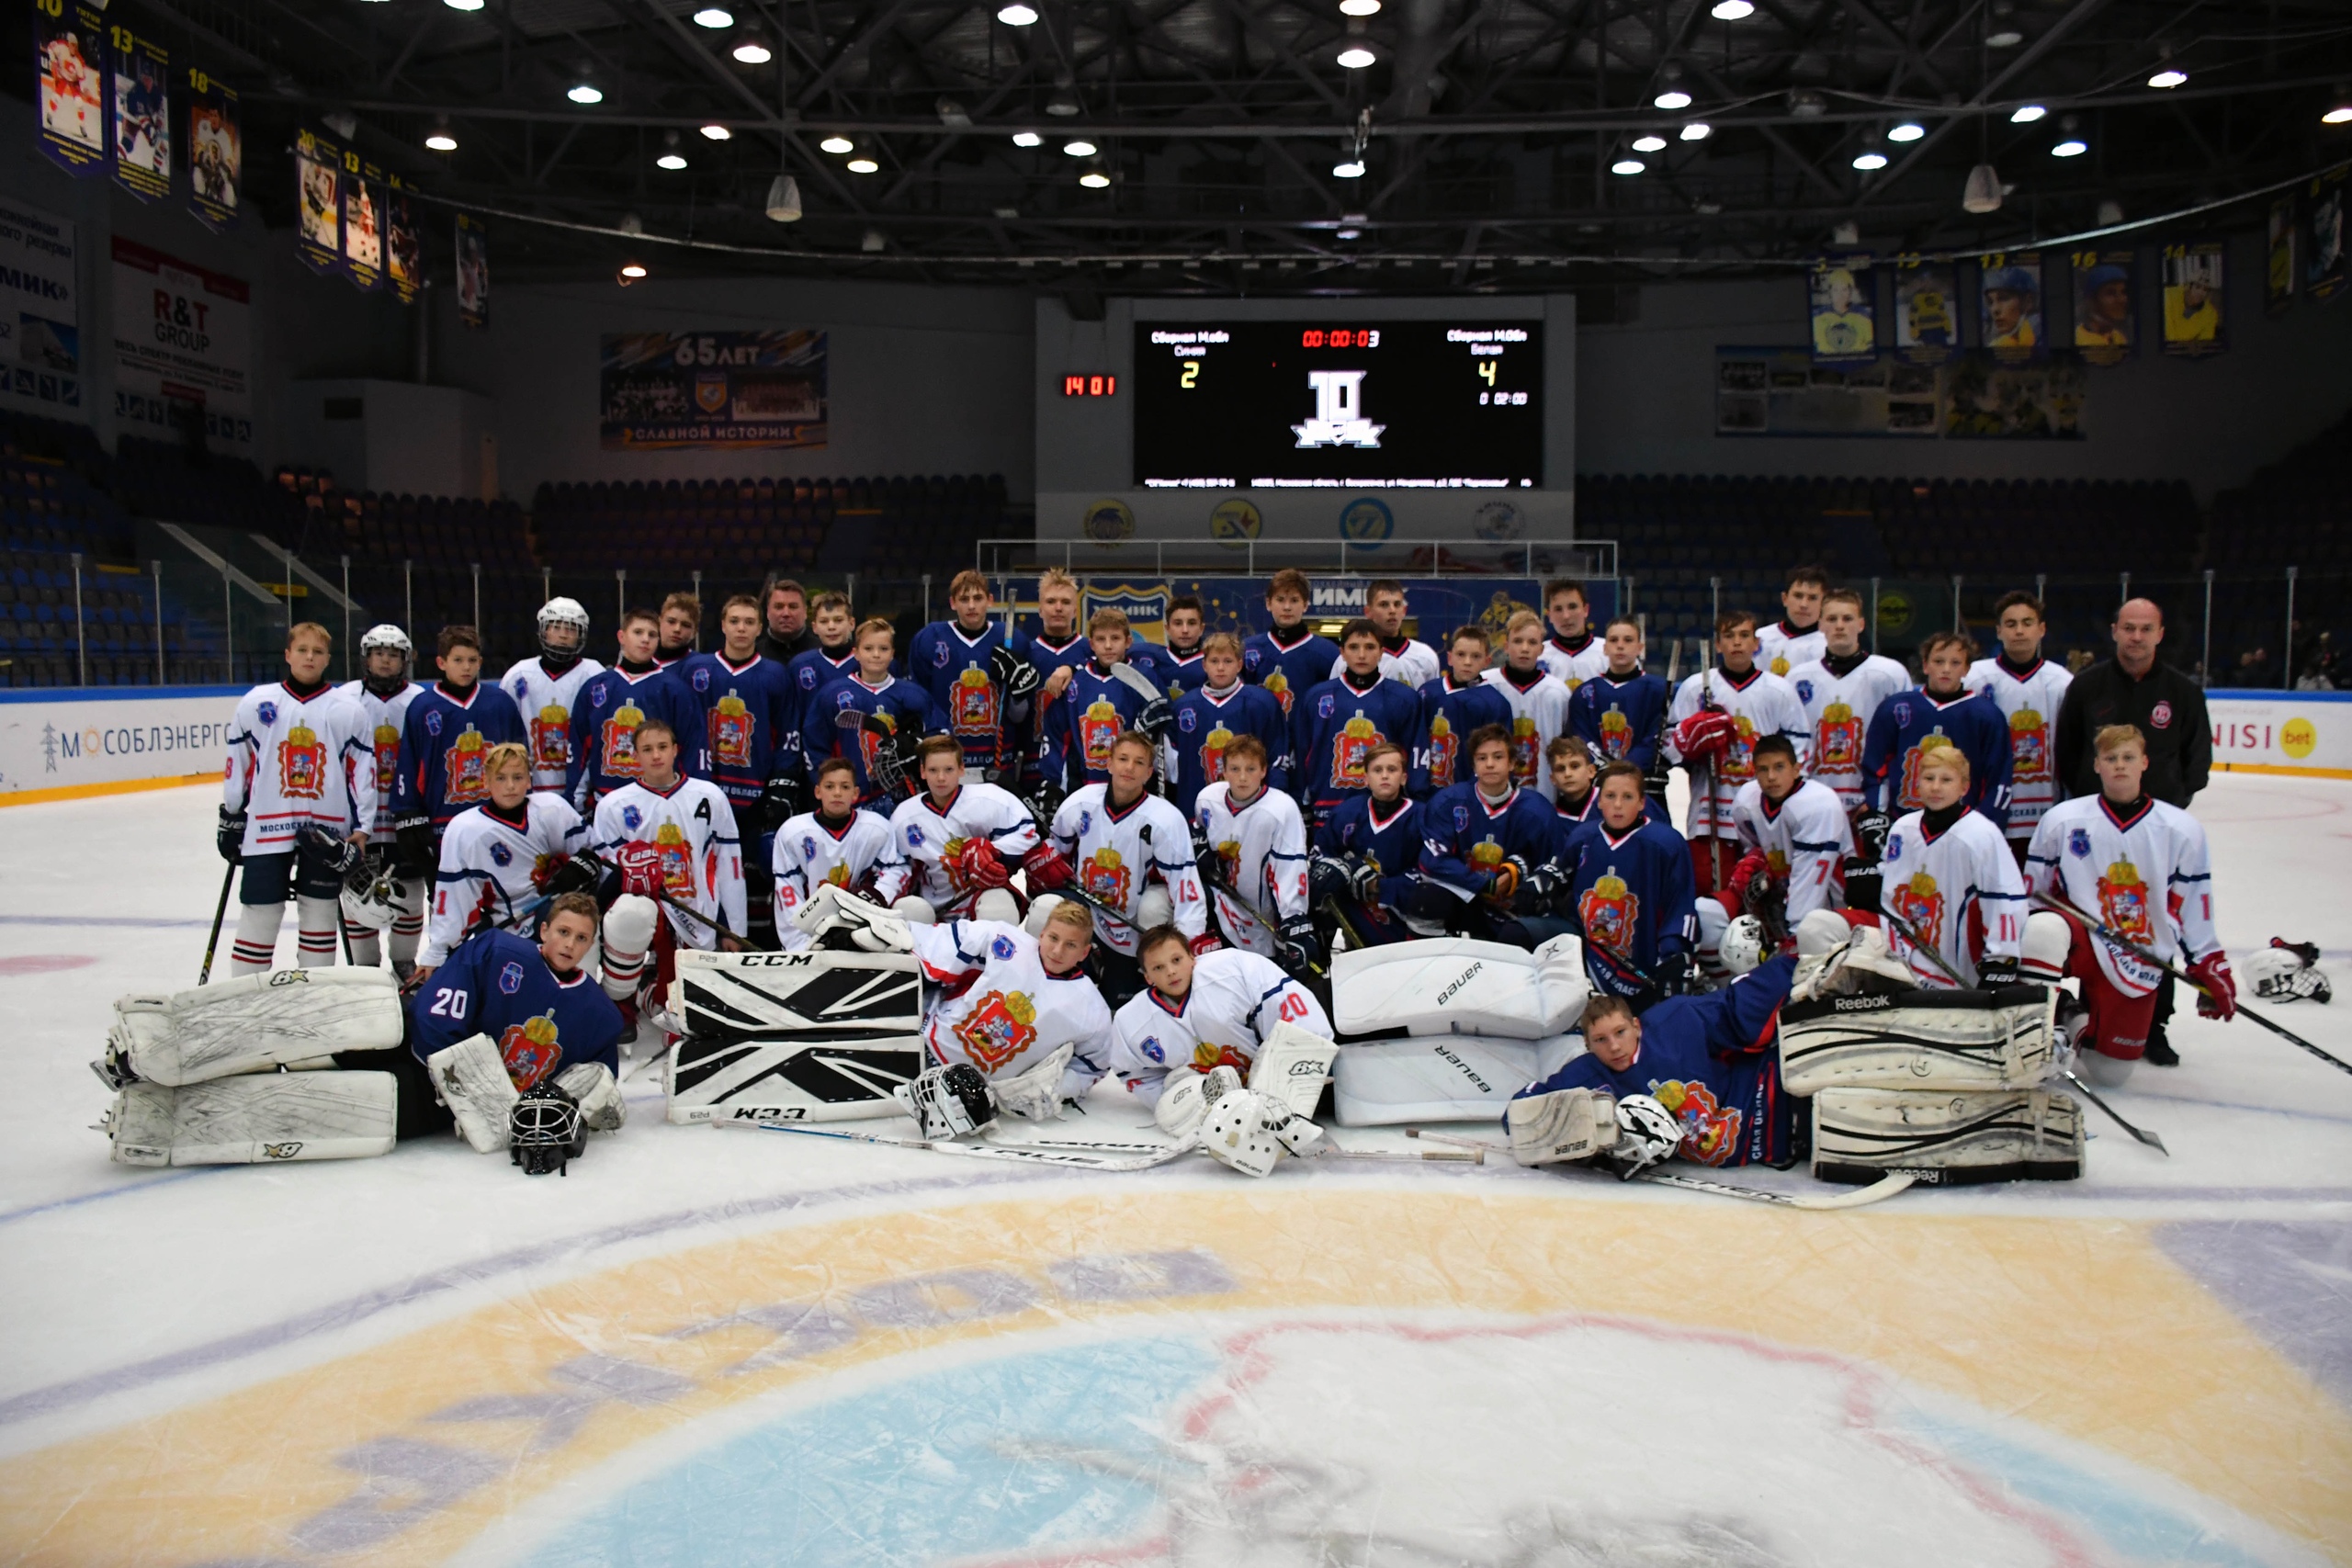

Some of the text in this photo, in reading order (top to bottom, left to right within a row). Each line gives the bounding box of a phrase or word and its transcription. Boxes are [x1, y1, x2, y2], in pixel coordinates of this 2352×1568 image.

[110, 25, 134, 54] 13
[344, 151, 359, 174] 13
[154, 288, 209, 333] R&T
[154, 322, 210, 354] GROUP
[1303, 330, 1380, 348] 00:00:03
[674, 336, 761, 367] 65 ЛЕТ
[1181, 361, 1200, 389] 2
[1478, 360, 1497, 387] 4
[635, 423, 791, 440] СЛАВНОЙ ИСТОРИИ
[1092, 604, 1159, 616] ХМИК
[783, 730, 800, 752] 13
[2286, 730, 2312, 745] bet
[1412, 746, 1430, 771] 14
[1993, 784, 2013, 811] 17
[695, 797, 711, 826] A
[1297, 873, 1307, 897] 9
[1815, 860, 1829, 886] 7
[1180, 879, 1199, 903] 13
[799, 897, 820, 919] CCM
[1682, 914, 1696, 942] 11
[2000, 913, 2017, 942] 11
[741, 954, 814, 966] CCM
[1437, 961, 1483, 1006] BAUER
[430, 987, 469, 1021] 20
[1280, 991, 1309, 1023] 20
[1834, 994, 1892, 1011] Reebok
[1434, 1044, 1492, 1093] BAUER
[733, 1108, 807, 1120] CCM
[1555, 1140, 1589, 1156] BAUER
[1235, 1158, 1263, 1175] BAUER
